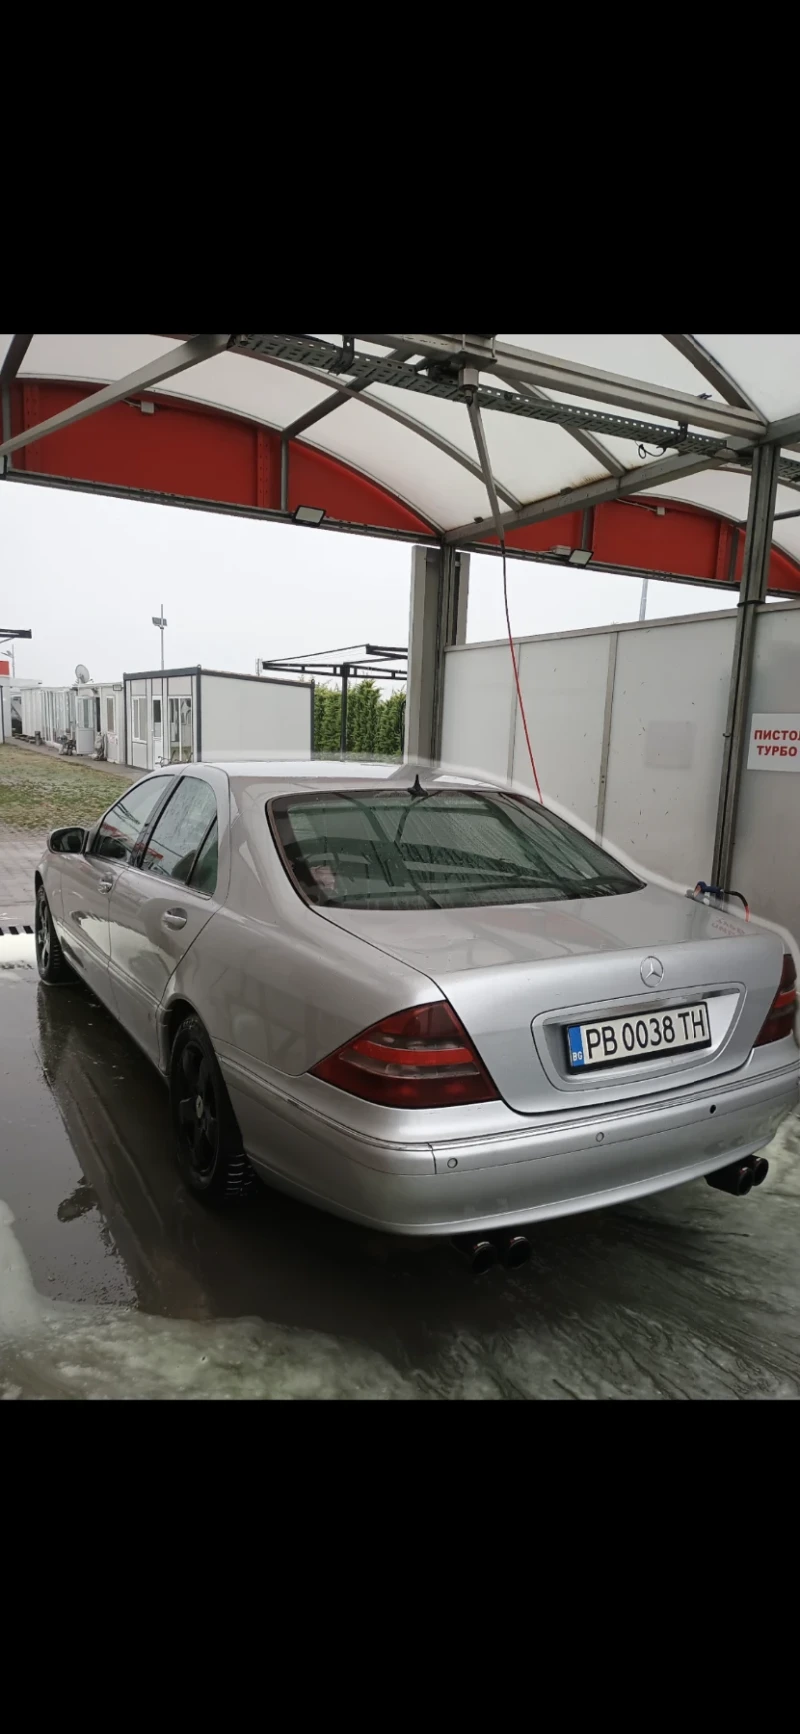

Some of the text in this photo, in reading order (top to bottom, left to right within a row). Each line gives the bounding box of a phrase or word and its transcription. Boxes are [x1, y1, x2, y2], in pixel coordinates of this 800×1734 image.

[757, 745, 798, 757] ТУРБО
[585, 1009, 705, 1059] PB 0038 TH
[572, 1051, 583, 1061] BG
